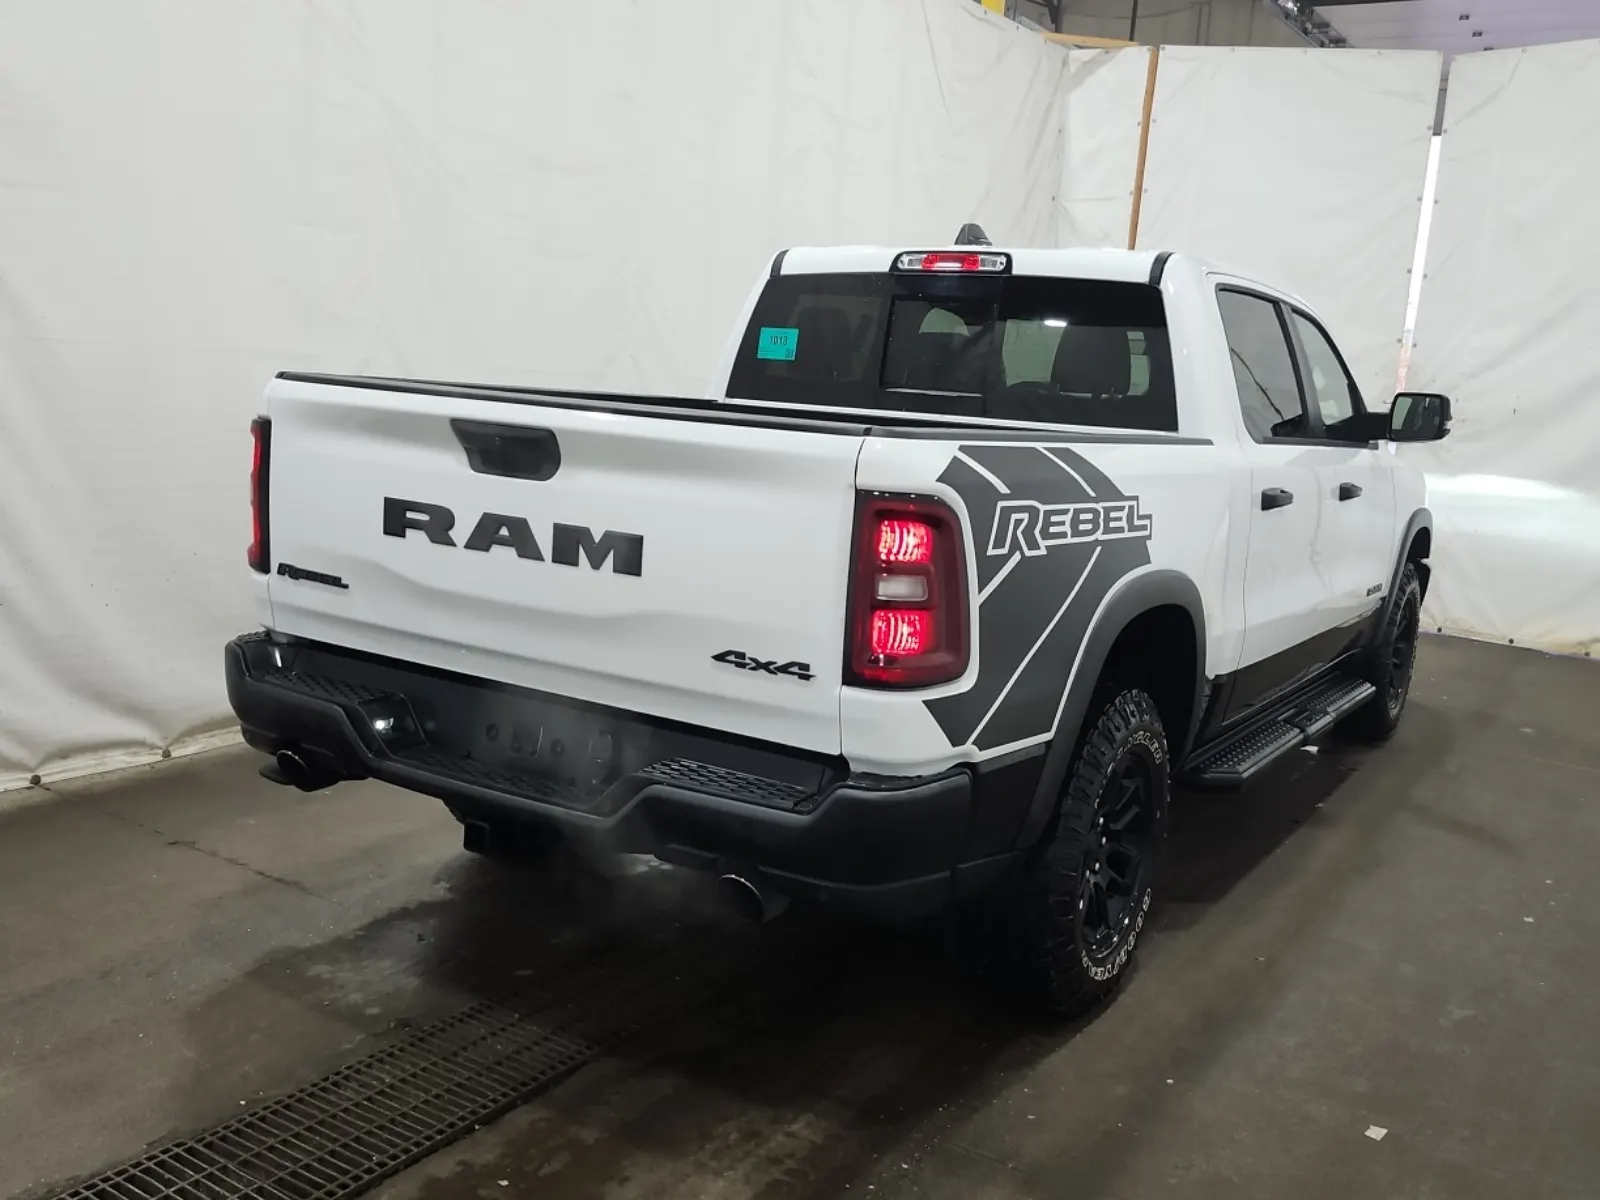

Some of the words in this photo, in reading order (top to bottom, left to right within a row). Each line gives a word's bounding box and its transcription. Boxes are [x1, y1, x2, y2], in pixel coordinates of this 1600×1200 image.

[769, 335, 788, 346] 1013
[383, 496, 644, 577] RAM
[987, 500, 1152, 556] REBEL
